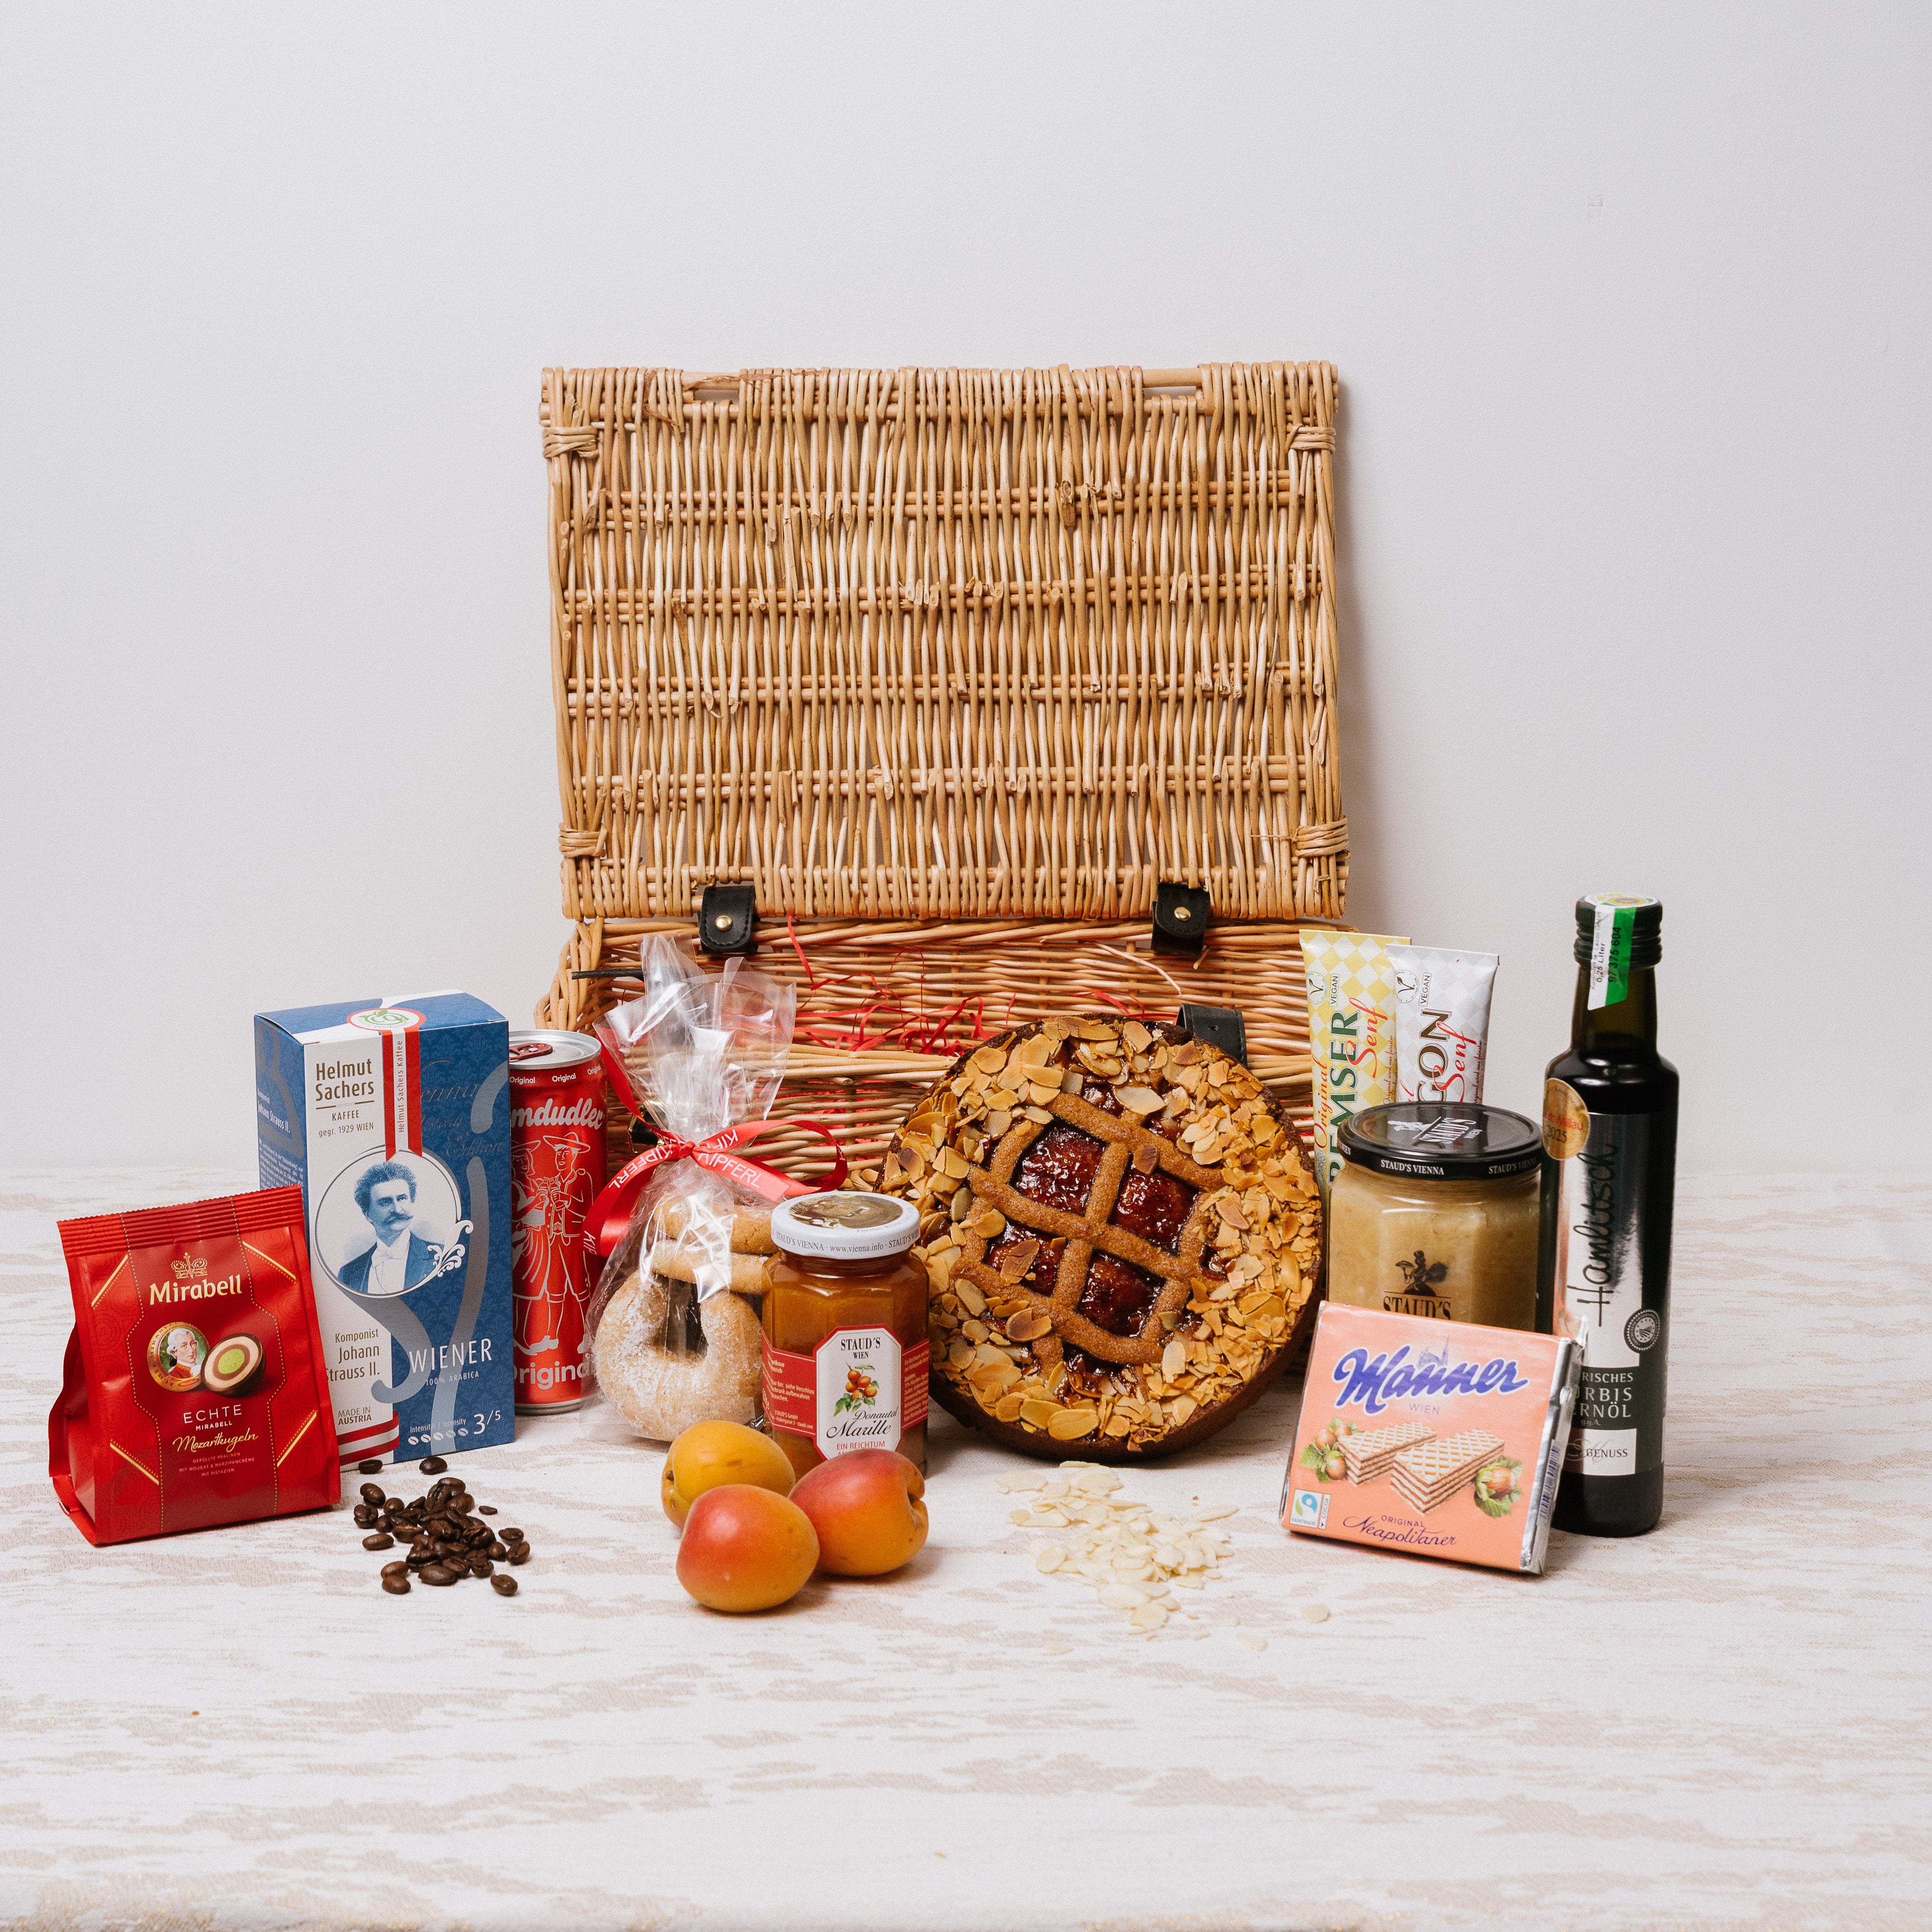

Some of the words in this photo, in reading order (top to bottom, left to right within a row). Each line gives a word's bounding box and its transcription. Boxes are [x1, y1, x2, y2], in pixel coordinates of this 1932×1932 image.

[1611, 926, 1622, 946] 604
[1608, 950, 1619, 968] 375
[1330, 976, 1338, 1004] VEGAN
[1420, 975, 1431, 1004] VEGAN
[1345, 997, 1388, 1079] Senf
[315, 1058, 373, 1081] Helmut
[1432, 1021, 1477, 1102] Senf
[552, 1072, 577, 1083] Original
[588, 1065, 601, 1076] Original
[509, 1076, 535, 1085] Original
[315, 1081, 375, 1102] Sachers
[1312, 1052, 1333, 1150] Original
[258, 1101, 270, 1120] Johann
[270, 1110, 284, 1130] Strauss
[332, 1110, 360, 1122] KAFFEE
[511, 1097, 603, 1130] mdudler
[319, 1129, 336, 1138] gegr.
[338, 1124, 354, 1134] 1929
[356, 1122, 374, 1132] WIEN
[608, 1143, 673, 1190] KIPFERL
[697, 1153, 761, 1188] KIPFERL
[1381, 1159, 1412, 1172] STAUD'S
[1414, 1165, 1445, 1176] VIENNA
[1488, 1162, 1517, 1175] STAUD'S
[776, 1231, 796, 1246] STAUD'S
[797, 1239, 824, 1251] VIENNA
[830, 1242, 884, 1253] www.vienna.info
[889, 1234, 911, 1249] STAUD'S
[149, 1274, 243, 1306] Mirabell
[335, 1327, 379, 1344] Komponist
[338, 1345, 380, 1365] Johann
[409, 1338, 492, 1374] WIENER
[853, 1351, 869, 1359] WIEN
[326, 1367, 365, 1382] trauss
[368, 1362, 380, 1377] II.
[425, 1375, 445, 1387] 100%
[449, 1370, 480, 1383] ARABICA
[1332, 1345, 1530, 1416] Manner
[1582, 1373, 1634, 1383] RISCHES
[771, 1387, 785, 1395] schrank
[786, 1390, 810, 1400] aufbewahren
[795, 1385, 815, 1395] Verschluss
[1577, 1387, 1632, 1402] RBIS
[183, 1404, 242, 1424] ECHTE
[338, 1408, 360, 1418] MADE
[363, 1406, 371, 1415] IN
[852, 1406, 899, 1420] Donautal
[1409, 1402, 1440, 1415] WIEN
[1579, 1401, 1631, 1418] RNÖL
[196, 1420, 233, 1431] MIRABELL
[338, 1414, 372, 1426] AUSTRIA
[442, 1417, 467, 1429] Intensity
[826, 1419, 892, 1439] Marille
[172, 1427, 259, 1453] Mozartkugeln
[850, 1441, 885, 1449] REICHTUM
[193, 1456, 216, 1464] GEFÜLLTE
[217, 1452, 241, 1460] PRALINEN
[1586, 1449, 1628, 1458] GENUSS
[211, 1467, 235, 1475] PISTAZIEN
[1321, 1497, 1329, 1519] COCOA
[1291, 1517, 1316, 1526] FAIRTRADE
[1381, 1514, 1425, 1528] ORIGINAL
[1343, 1515, 1457, 1546] Neapolitaner
